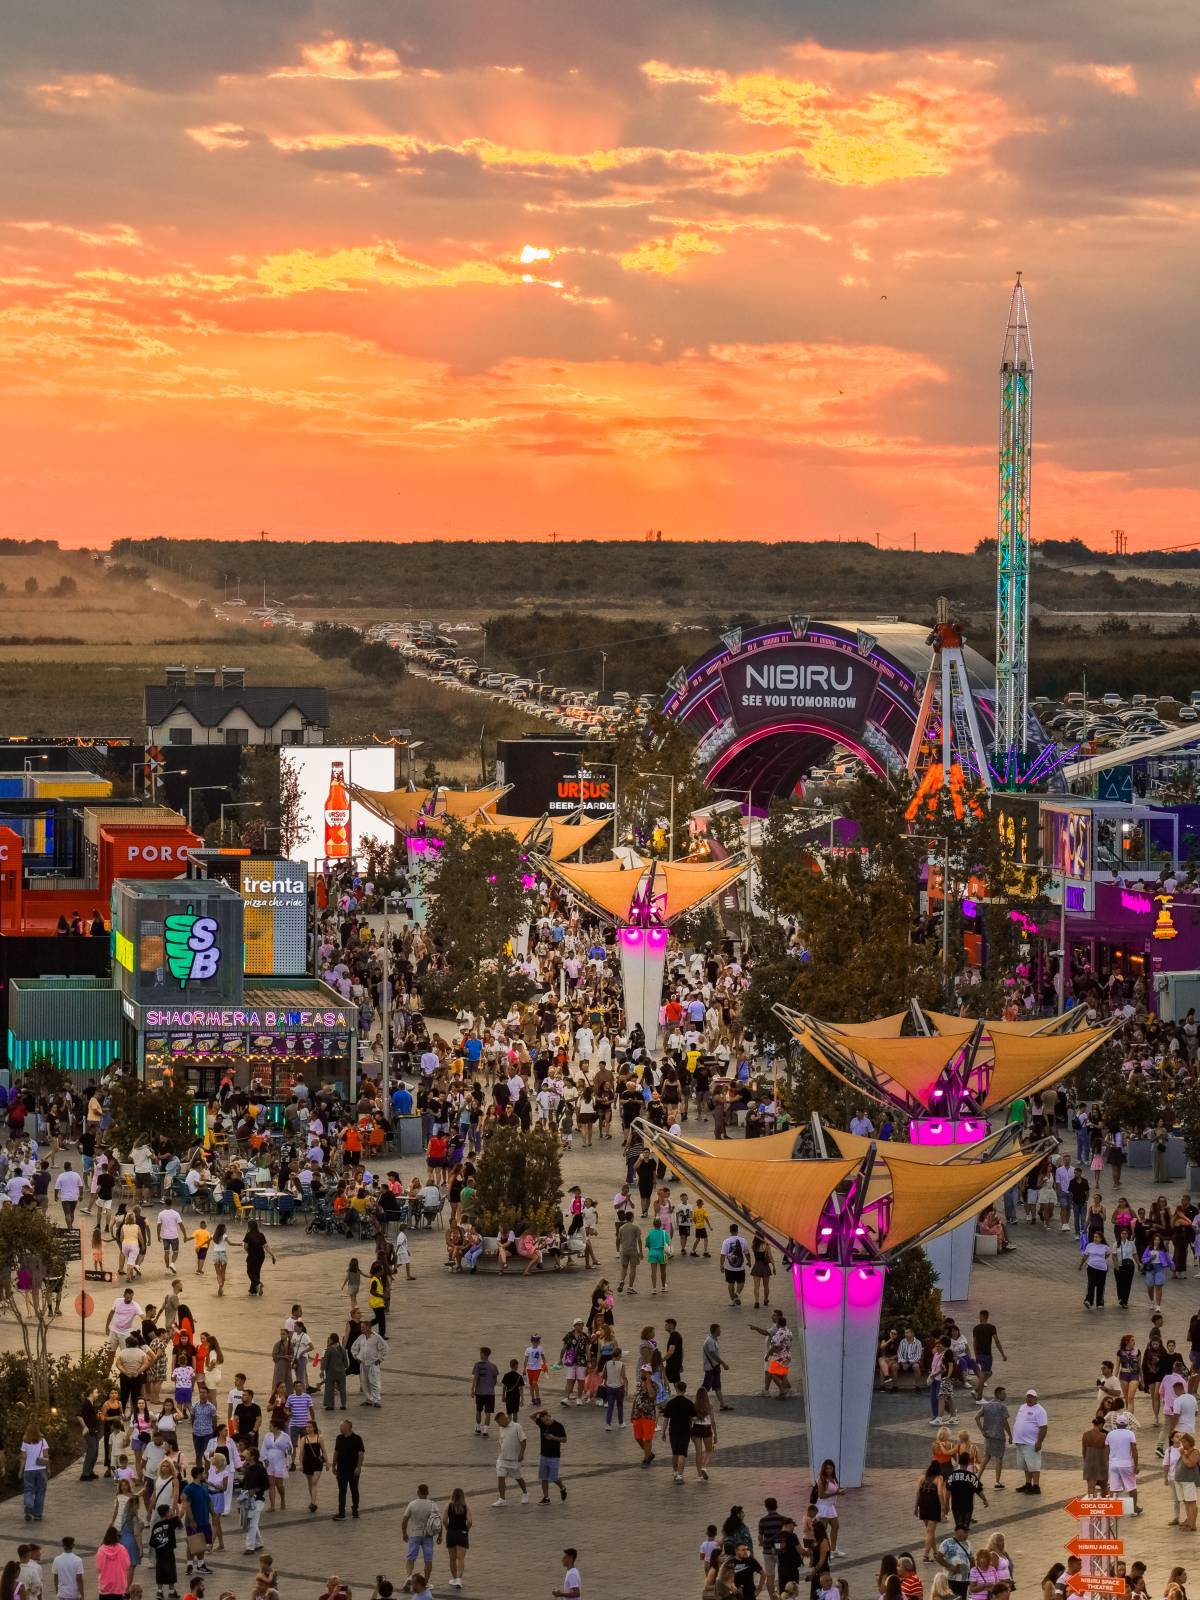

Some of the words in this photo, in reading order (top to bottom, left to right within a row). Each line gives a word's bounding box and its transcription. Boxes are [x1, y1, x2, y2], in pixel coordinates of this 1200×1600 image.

[746, 664, 853, 691] NIBIRU
[742, 694, 763, 706] SEE
[765, 695, 787, 707] YOU
[790, 695, 857, 708] TOMORROW
[558, 782, 609, 800] URSUS
[549, 801, 575, 810] BEER
[243, 876, 304, 893] trenta
[243, 897, 267, 909] pizza
[268, 896, 285, 907] che
[285, 898, 304, 907] ride
[146, 1010, 260, 1027] SHAORMERIA
[265, 1011, 347, 1027] BANEASA
